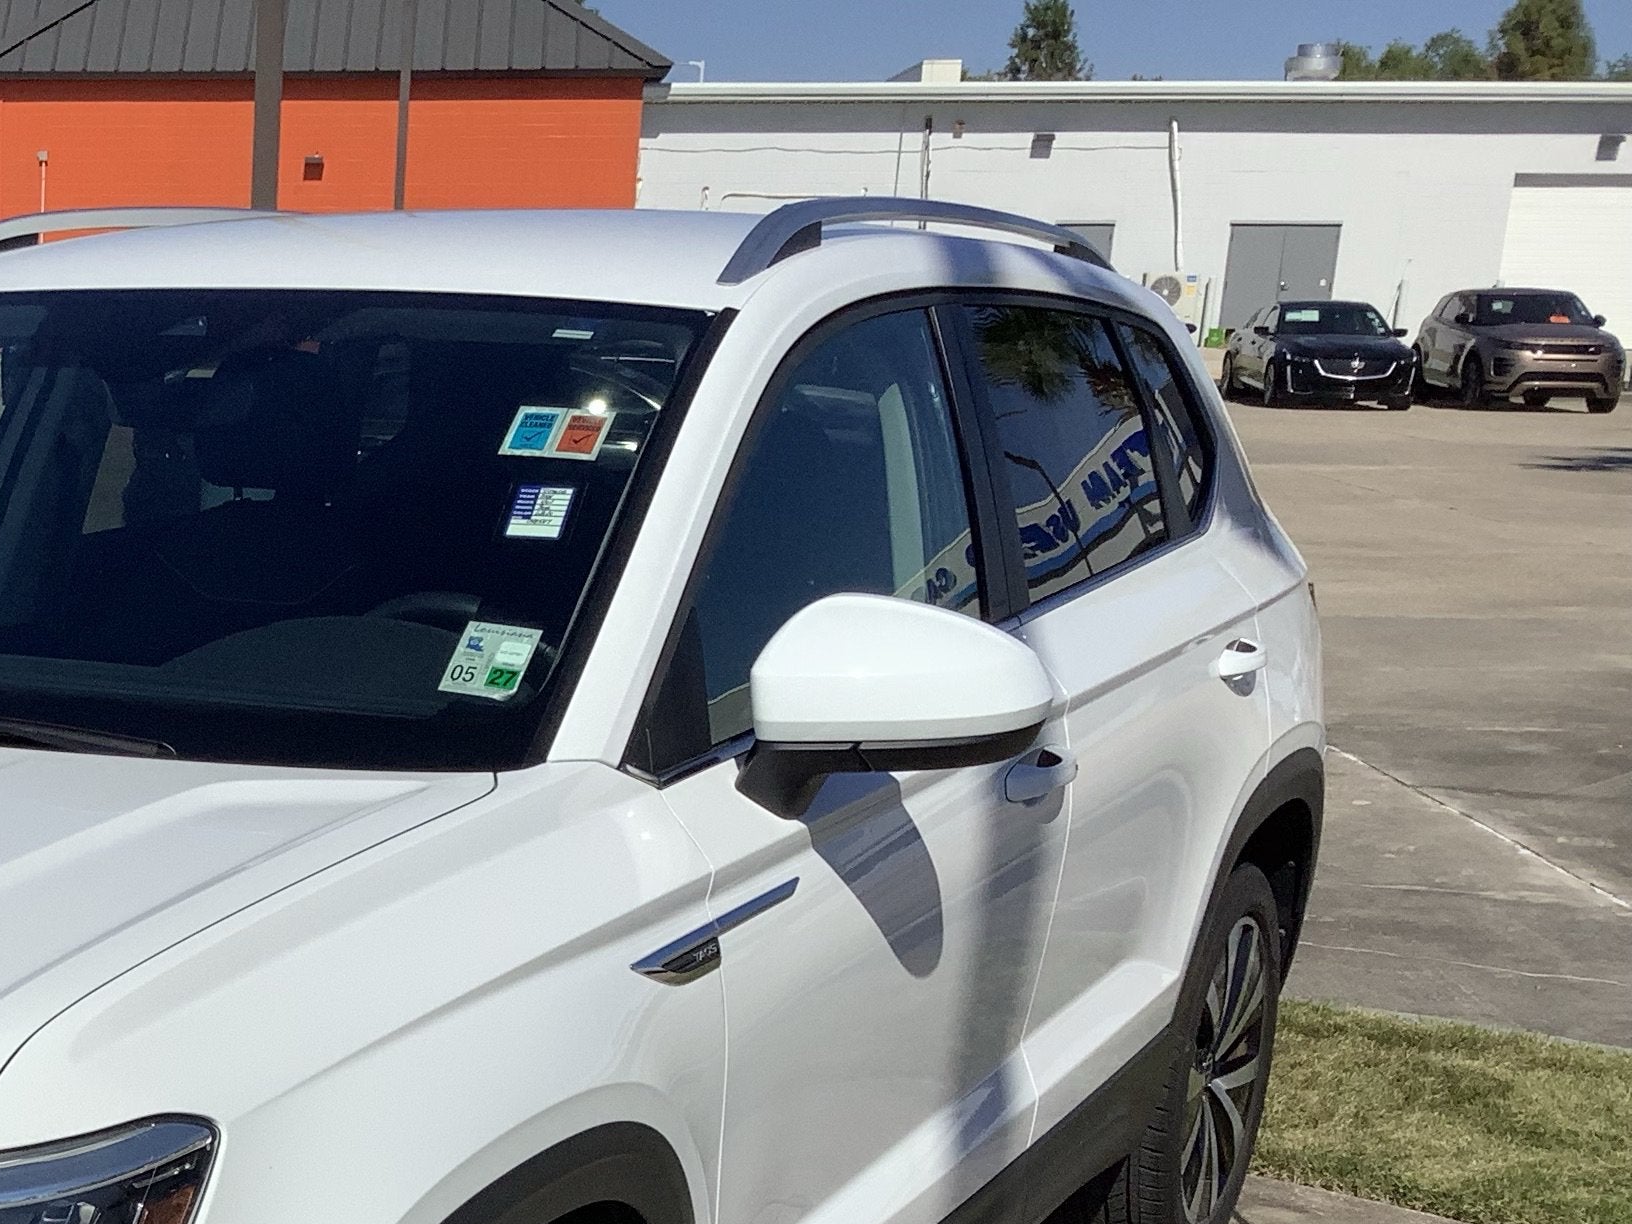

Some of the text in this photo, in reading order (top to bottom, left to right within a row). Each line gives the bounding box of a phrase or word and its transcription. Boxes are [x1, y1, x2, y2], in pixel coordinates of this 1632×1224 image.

[474, 623, 533, 638] Louisiana
[450, 664, 517, 686] 05 27
